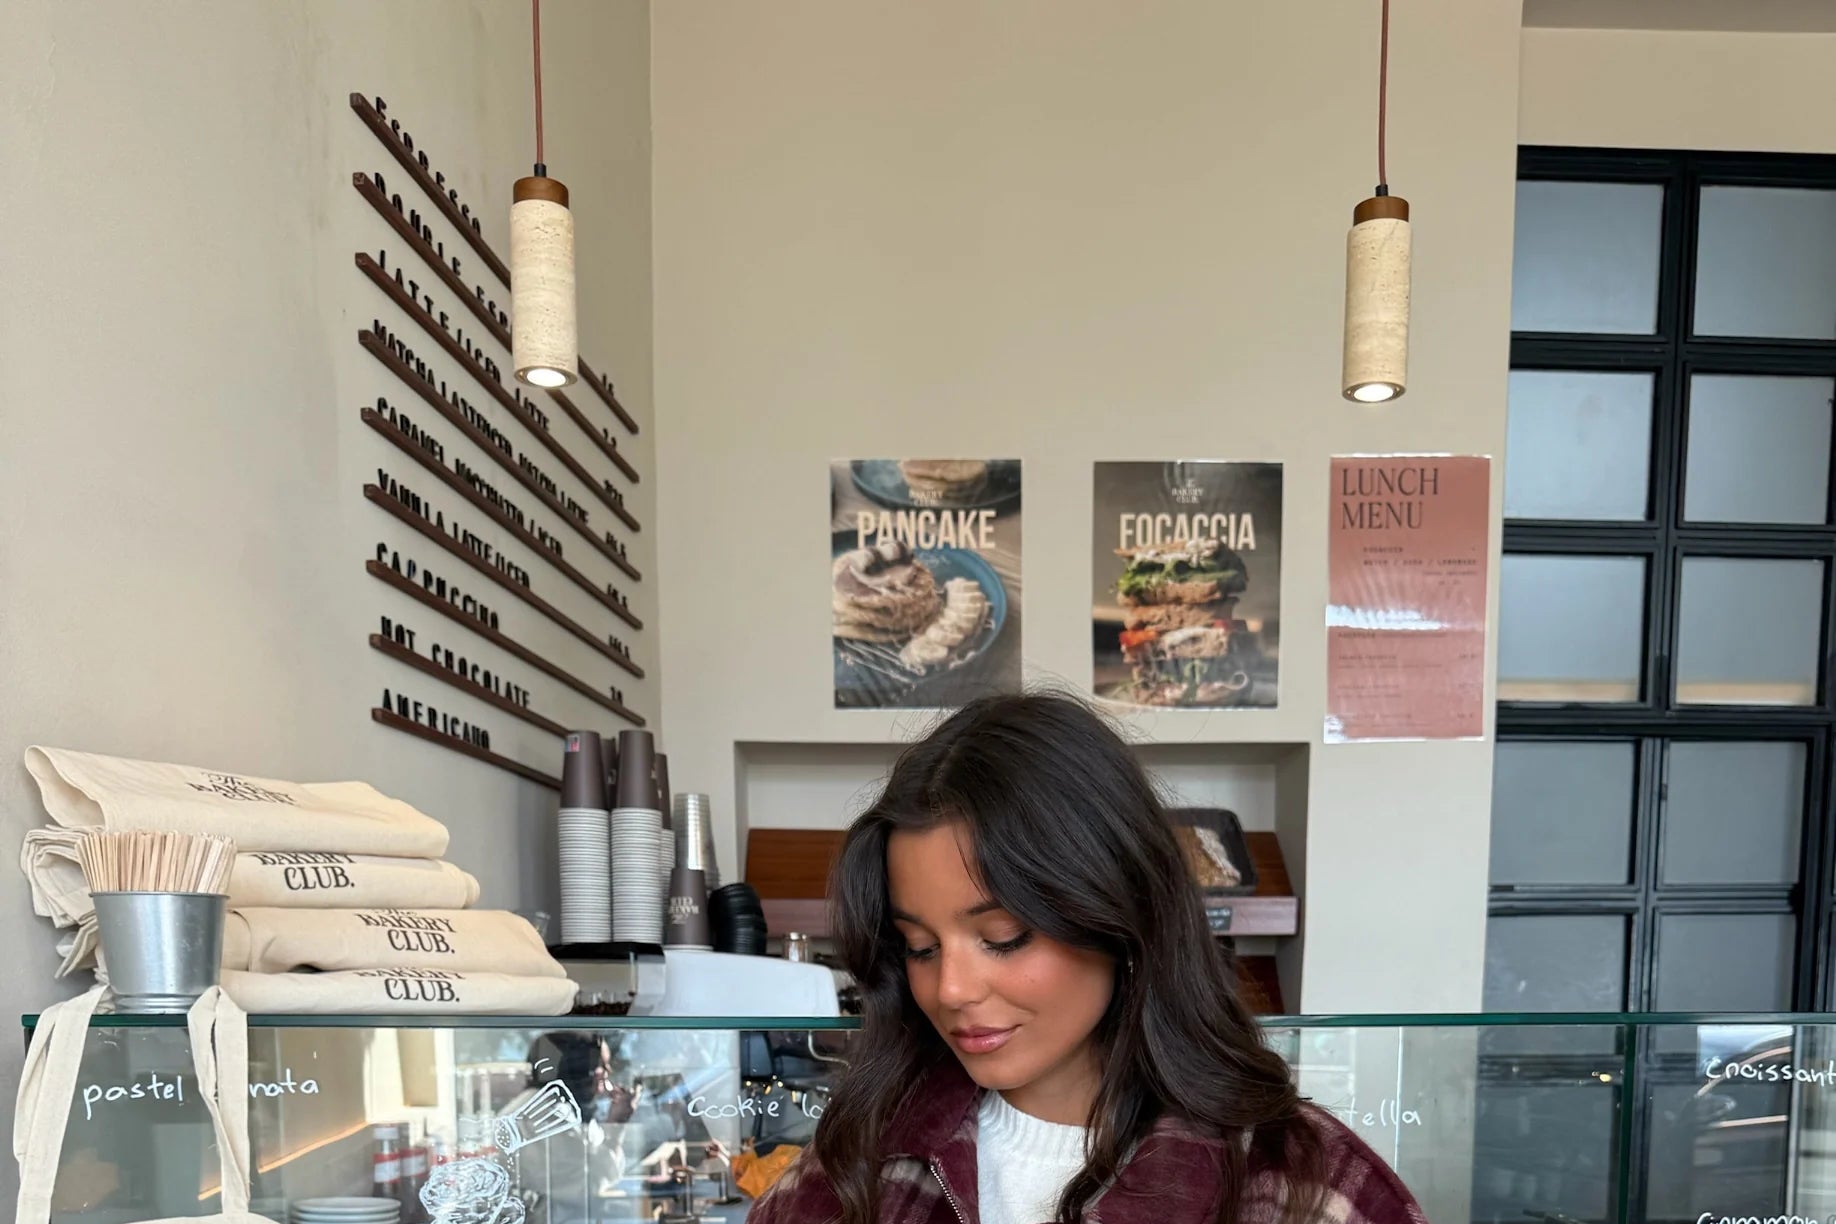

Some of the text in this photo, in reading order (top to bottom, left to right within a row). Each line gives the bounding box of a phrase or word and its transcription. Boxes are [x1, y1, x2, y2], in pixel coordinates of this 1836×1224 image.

[375, 96, 481, 238] ESPRESSO
[374, 171, 460, 277] DOUBLE
[373, 318, 435, 391] MATCHA
[1342, 467, 1439, 496] LUNCH
[856, 509, 996, 549] PANCAKE
[1119, 512, 1257, 550] FOCACCIA
[1341, 501, 1424, 530] MENU
[380, 615, 531, 710] HOT CHOCOLATE
[382, 688, 492, 752] AMERICANO
[284, 865, 355, 890] CLUB.
[354, 912, 457, 933] BAKERY
[387, 928, 455, 954] CLUB.
[384, 977, 460, 1003] CLUB.
[83, 1068, 319, 1121] pastel nata
[687, 1095, 785, 1119] Cookie
